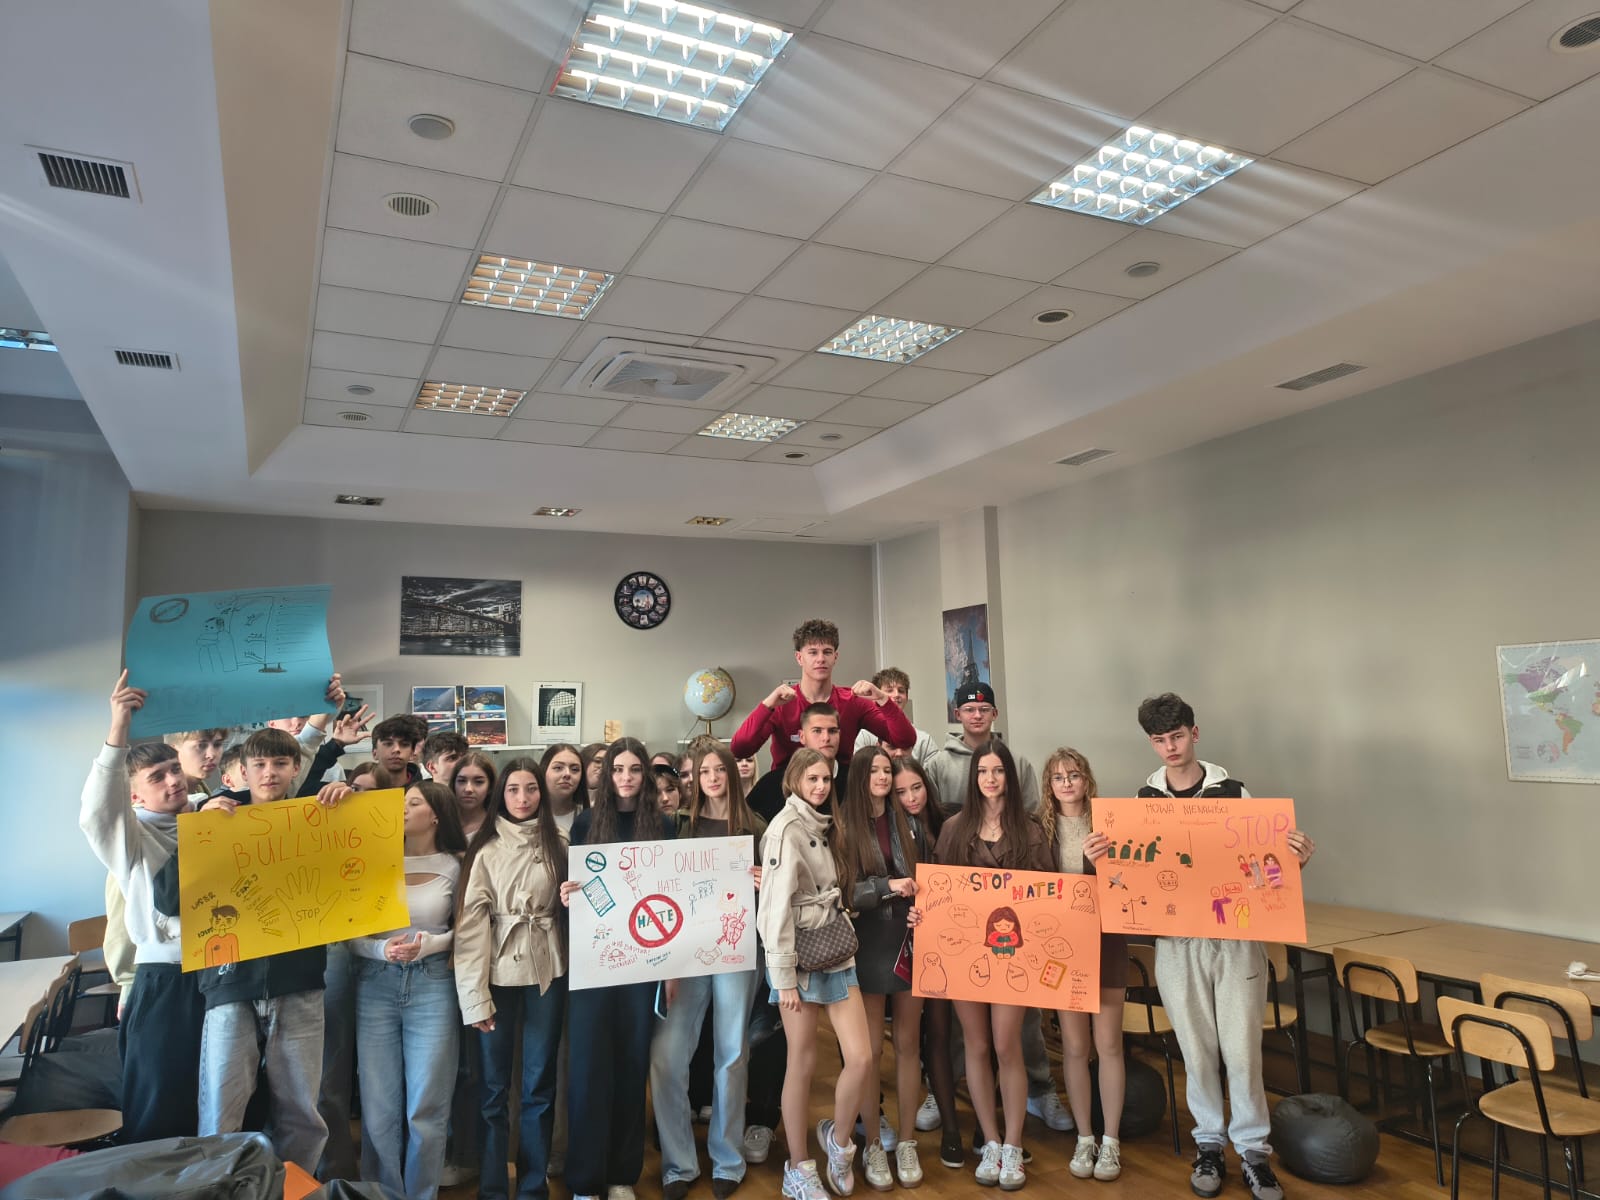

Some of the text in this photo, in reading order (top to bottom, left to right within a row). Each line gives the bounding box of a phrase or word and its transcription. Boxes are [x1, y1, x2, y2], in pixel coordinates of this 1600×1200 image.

[248, 802, 340, 837] STOP
[1145, 802, 1175, 815] MOWA
[1224, 812, 1289, 849] STOP
[232, 827, 362, 875] BULLYING
[618, 845, 721, 873] STOP ONLINE
[657, 877, 683, 893] HATE
[1012, 878, 1063, 901] HATE!
[295, 908, 321, 922] STOP
[637, 908, 674, 929] HATE
